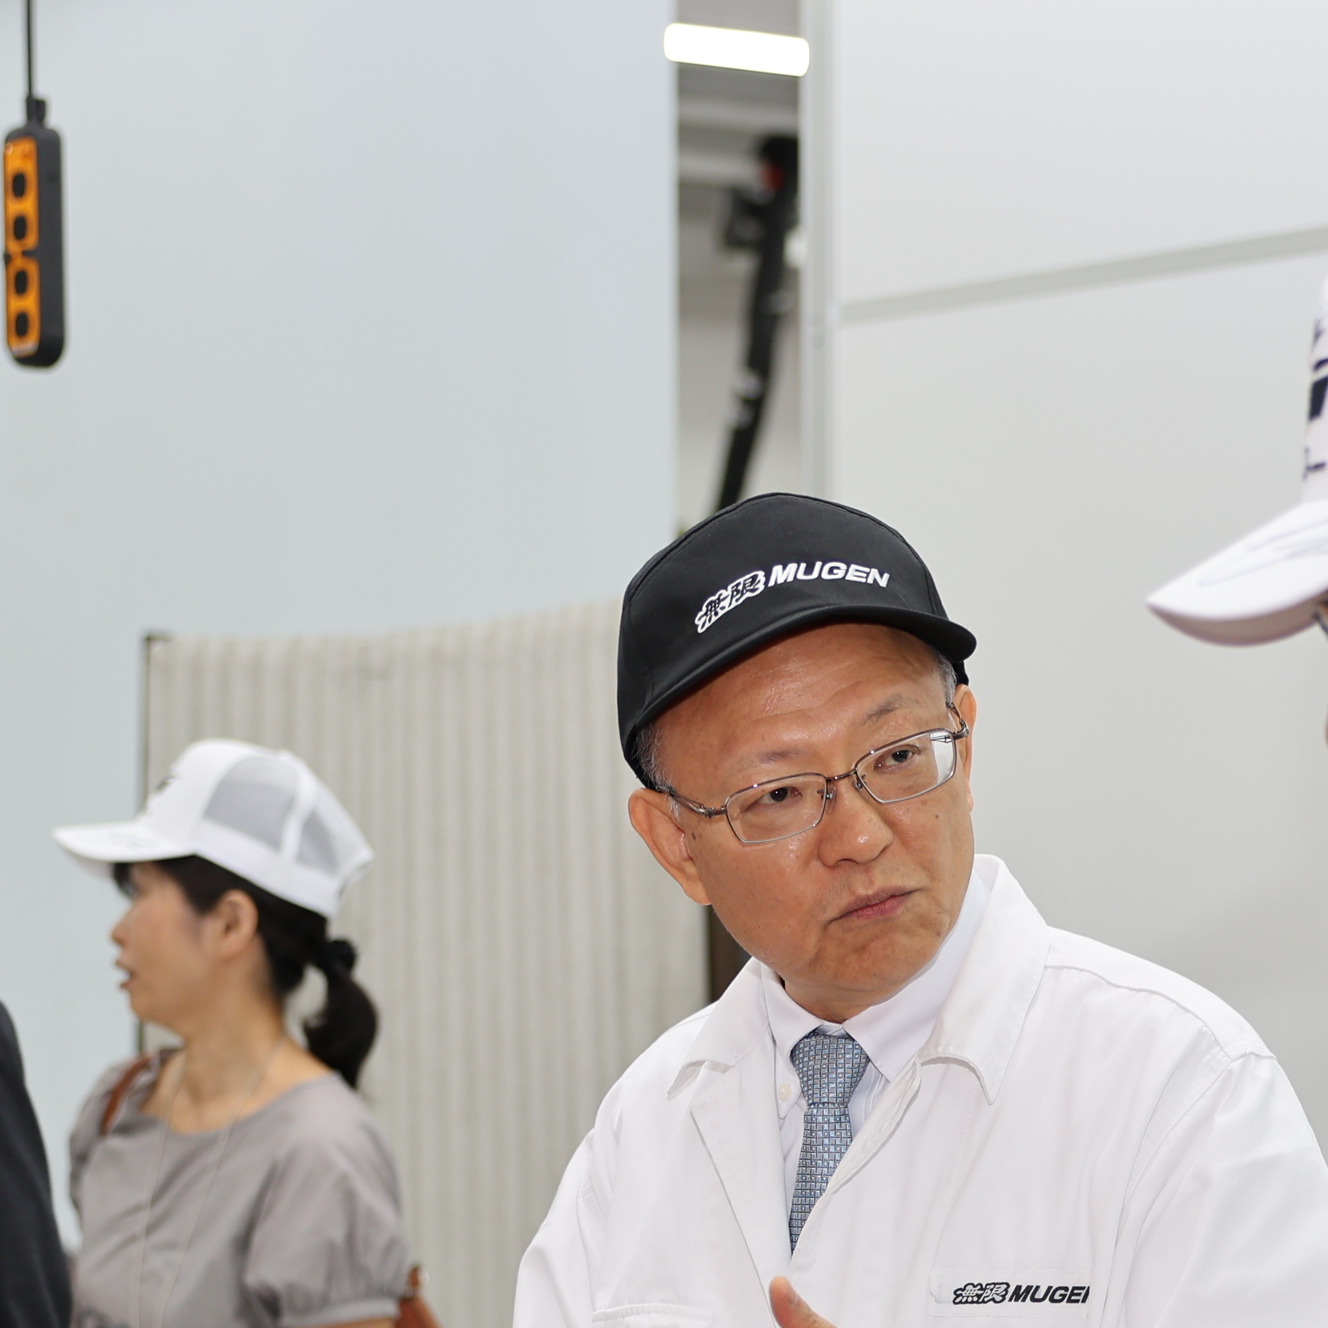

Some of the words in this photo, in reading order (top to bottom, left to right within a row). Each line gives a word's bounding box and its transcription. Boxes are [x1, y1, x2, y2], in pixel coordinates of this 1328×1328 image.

[695, 570, 766, 634] 無限
[768, 561, 890, 588] MUGEN
[952, 1282, 1011, 1305] 無限
